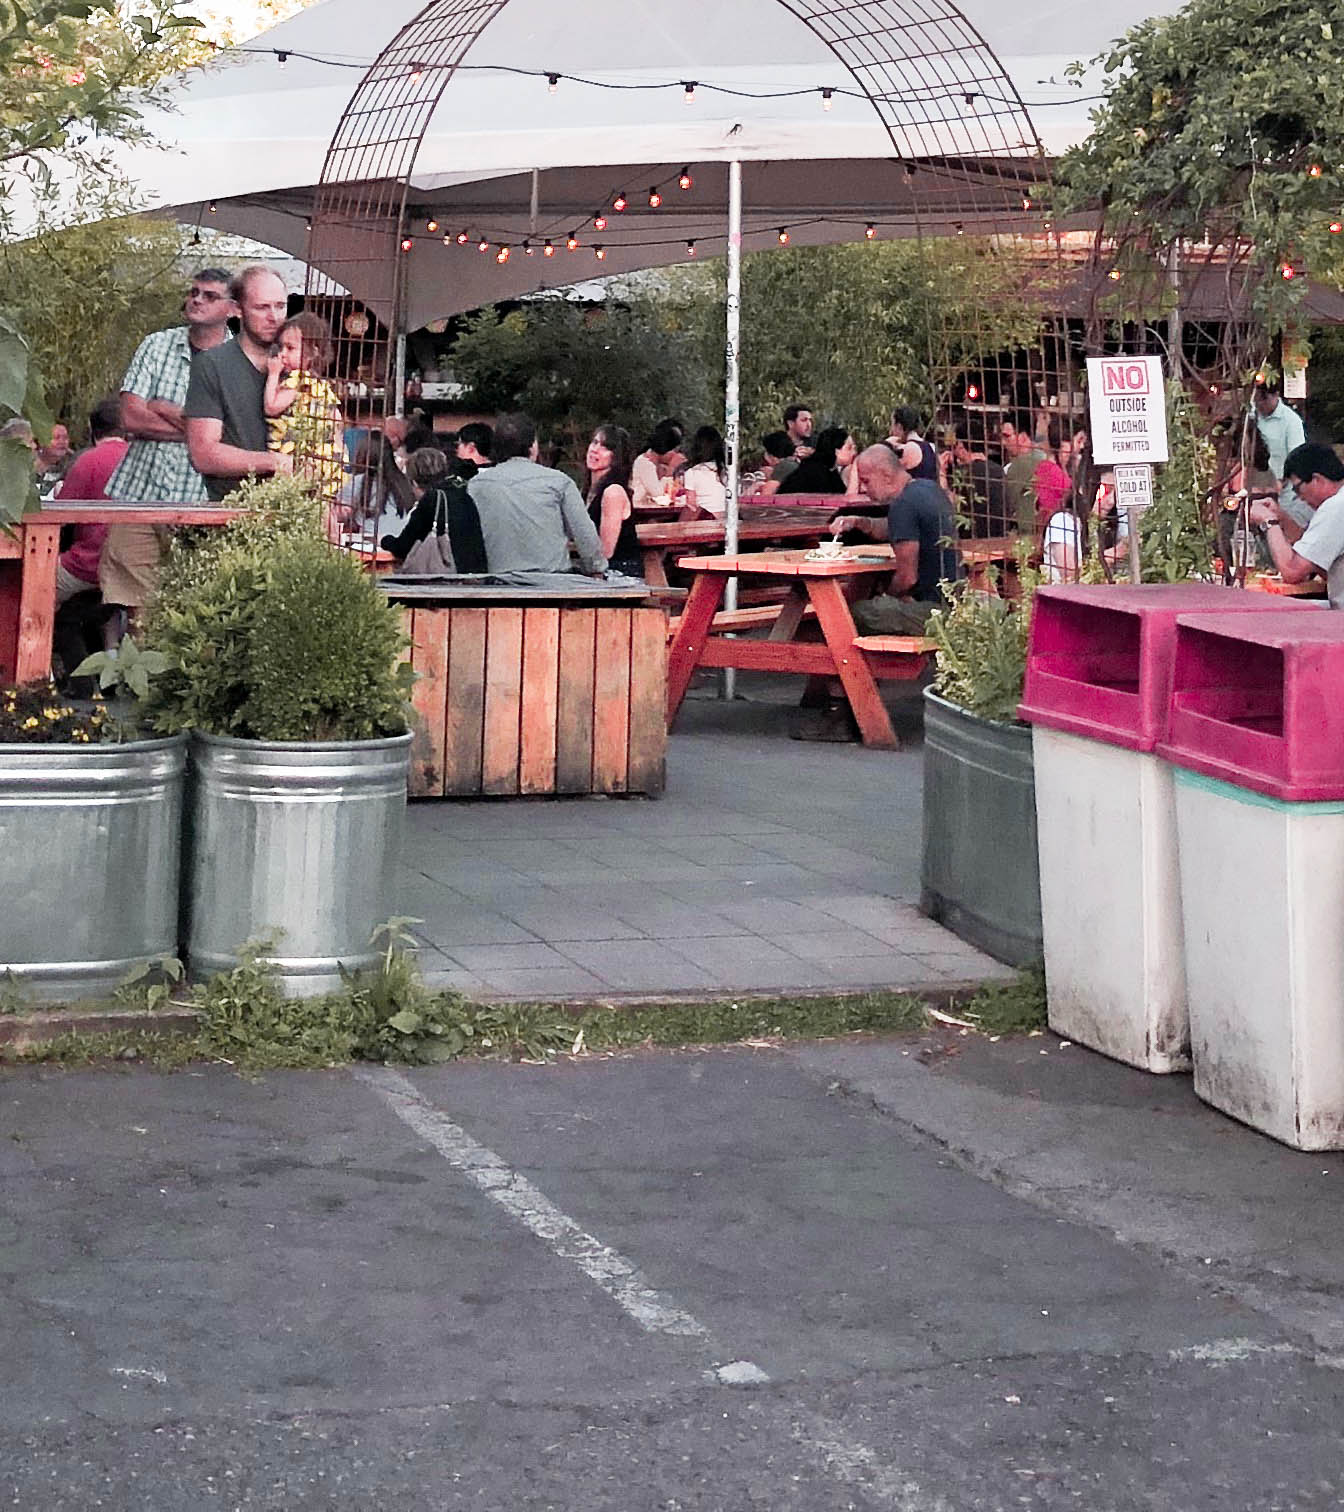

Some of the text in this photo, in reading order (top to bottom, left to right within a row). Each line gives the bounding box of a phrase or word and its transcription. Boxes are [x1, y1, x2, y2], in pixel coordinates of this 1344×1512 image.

[1107, 366, 1143, 389] NO
[1110, 398, 1146, 412] OUTSIDE
[1112, 419, 1148, 433] ALCOHOL
[1113, 441, 1149, 452] PERMITTED
[1120, 480, 1146, 492] SOLD AT
